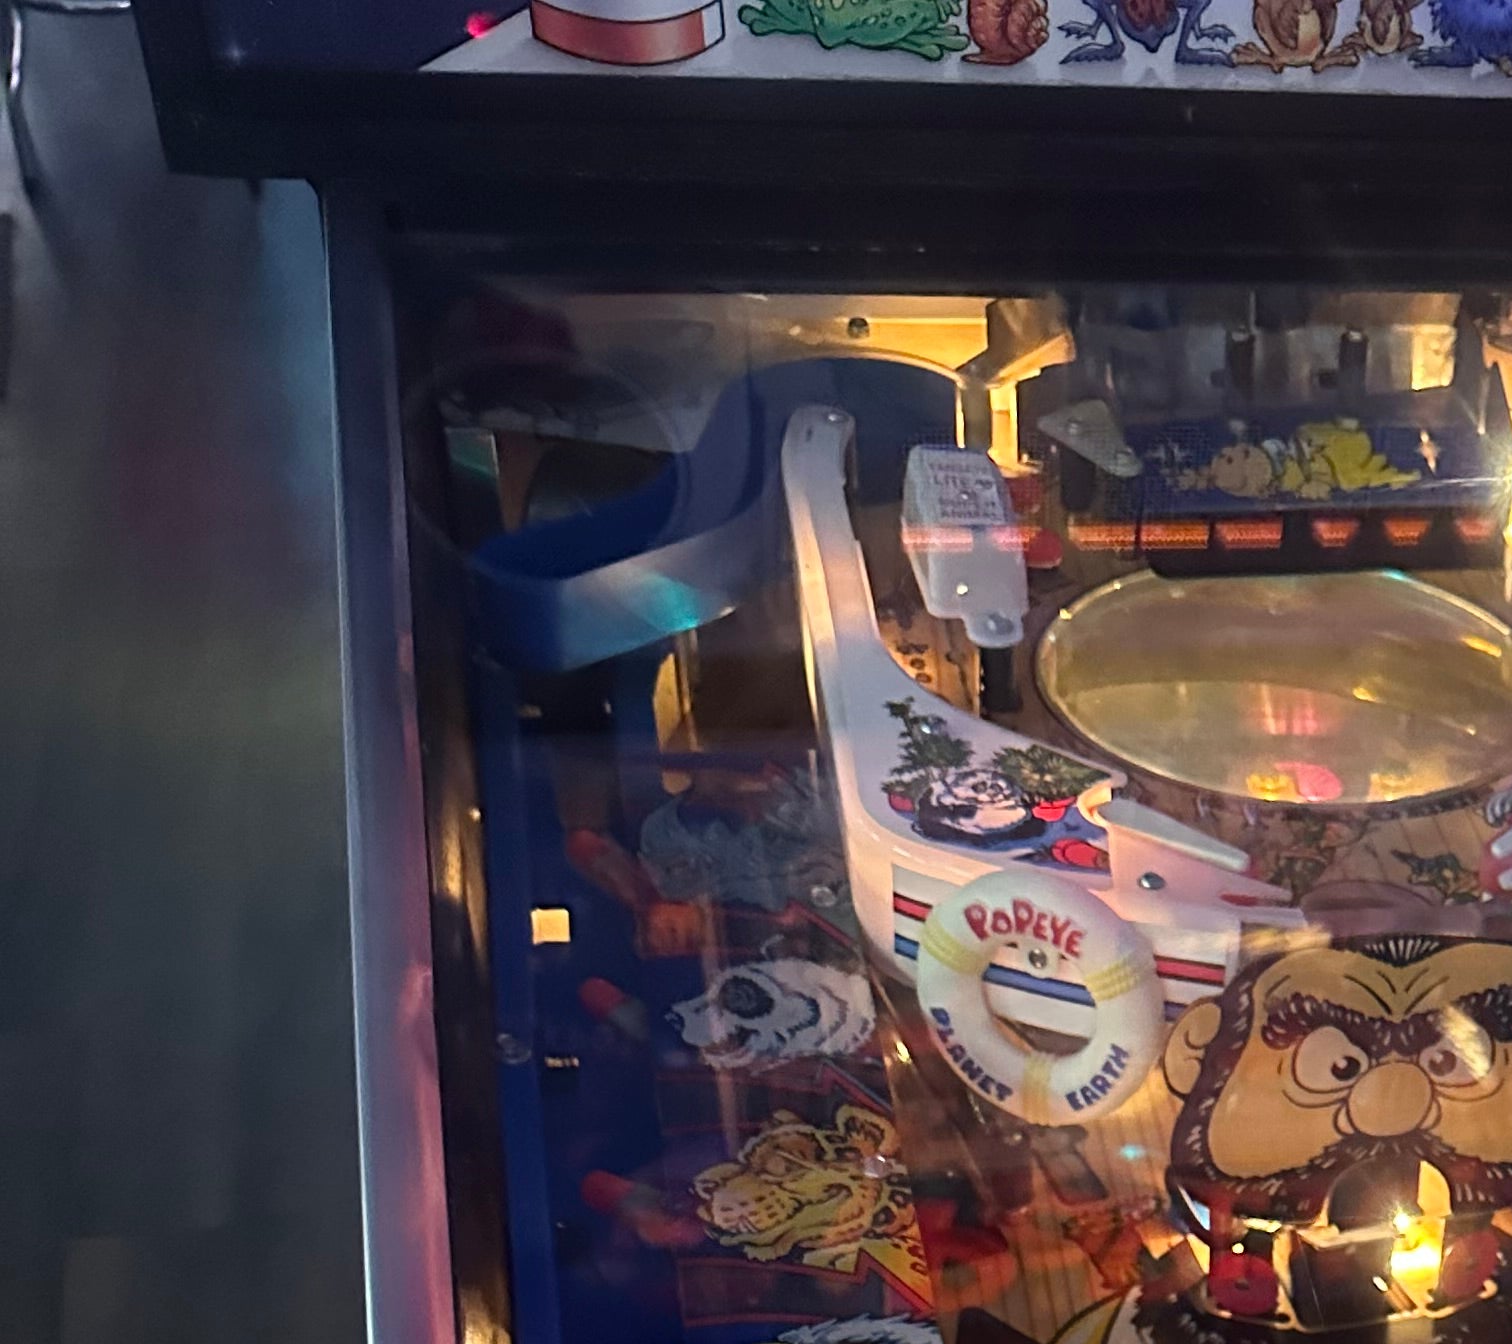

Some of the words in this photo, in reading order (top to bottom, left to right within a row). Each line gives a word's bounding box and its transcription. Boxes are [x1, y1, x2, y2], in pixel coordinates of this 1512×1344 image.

[963, 897, 1087, 958] POPEYE
[930, 1007, 1013, 1101] PLANET
[1065, 1042, 1129, 1111] EARTH
